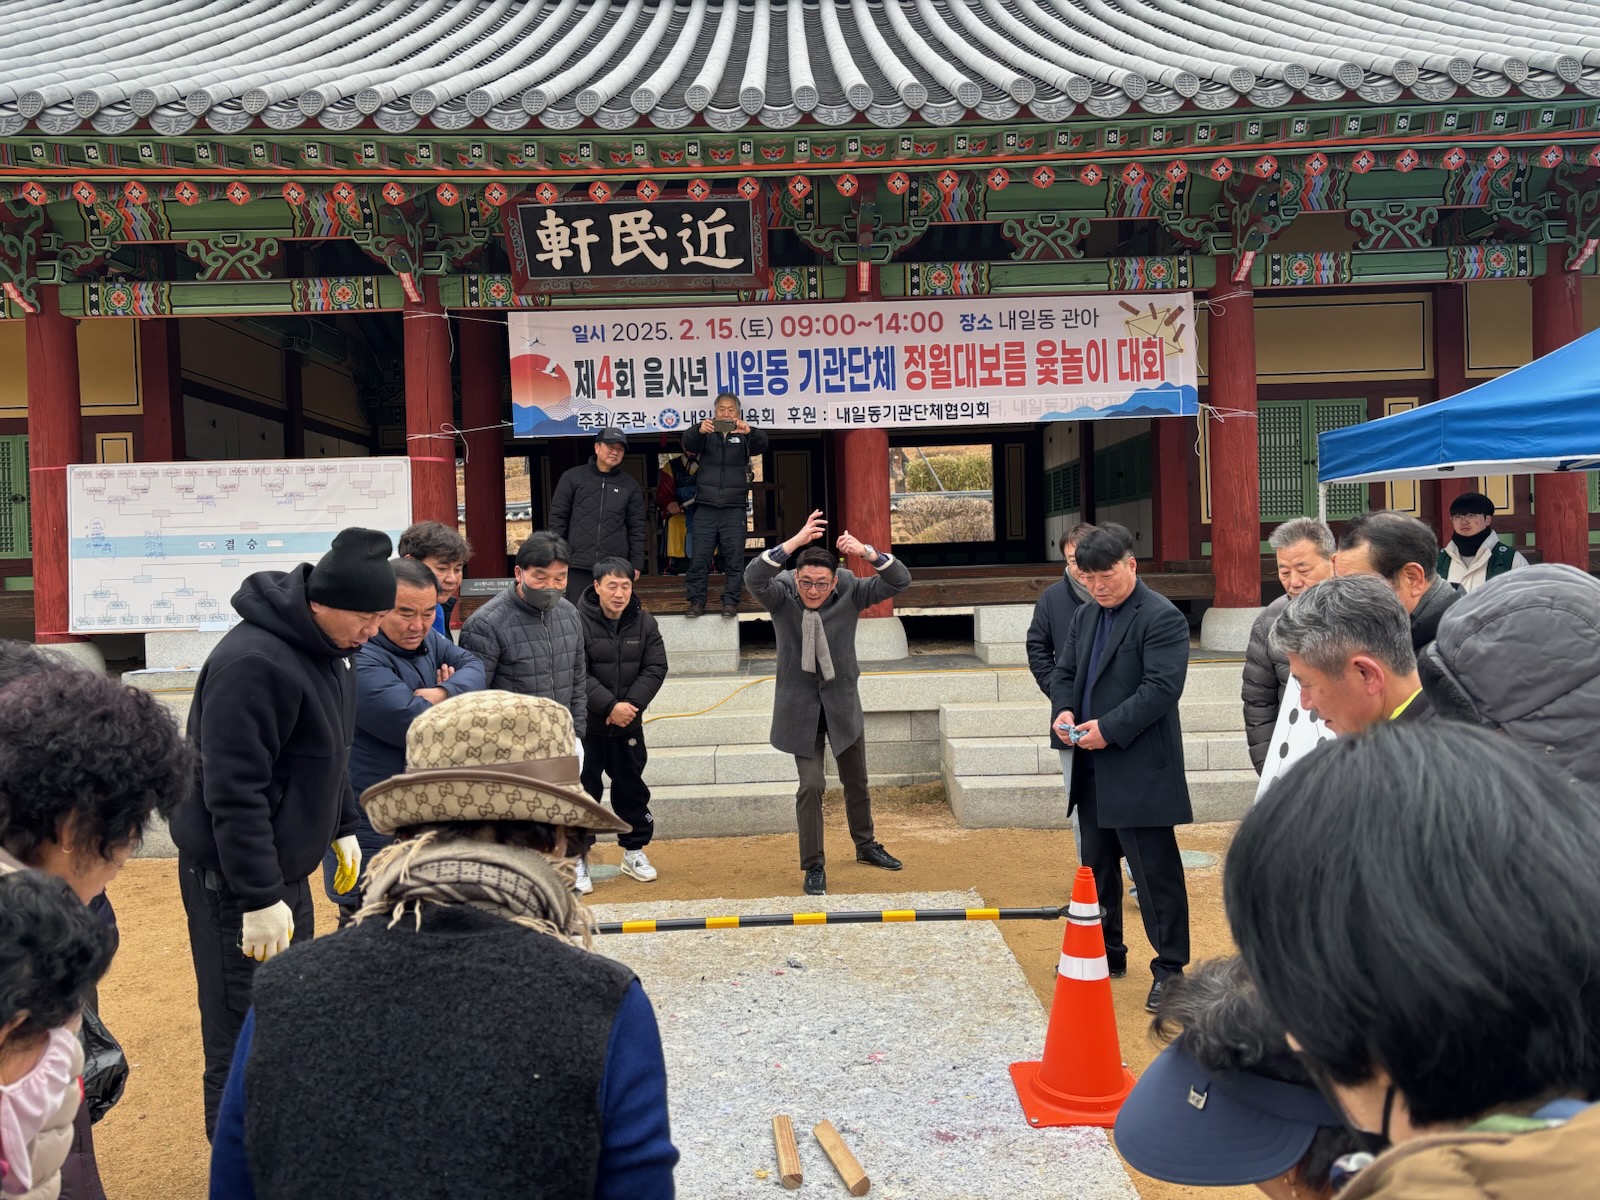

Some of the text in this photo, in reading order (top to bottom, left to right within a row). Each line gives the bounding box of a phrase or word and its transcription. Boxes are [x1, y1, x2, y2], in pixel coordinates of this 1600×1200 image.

[571, 324, 606, 343] 일시
[612, 322, 673, 342] 2025.
[679, 319, 700, 341] 2.
[780, 311, 944, 338] 09:00~14:00
[959, 313, 994, 332] 장소
[999, 308, 1055, 331] 내일동
[1061, 307, 1100, 329] 관아
[573, 336, 1166, 399] 제4회 을사년 내일동 기관단체 정월대보름 윷놀이 대회
[578, 410, 647, 429] 주최/주관
[683, 408, 775, 426] 내일육회
[787, 406, 817, 424] 후원
[836, 401, 990, 424] 내일동기관단체협의회
